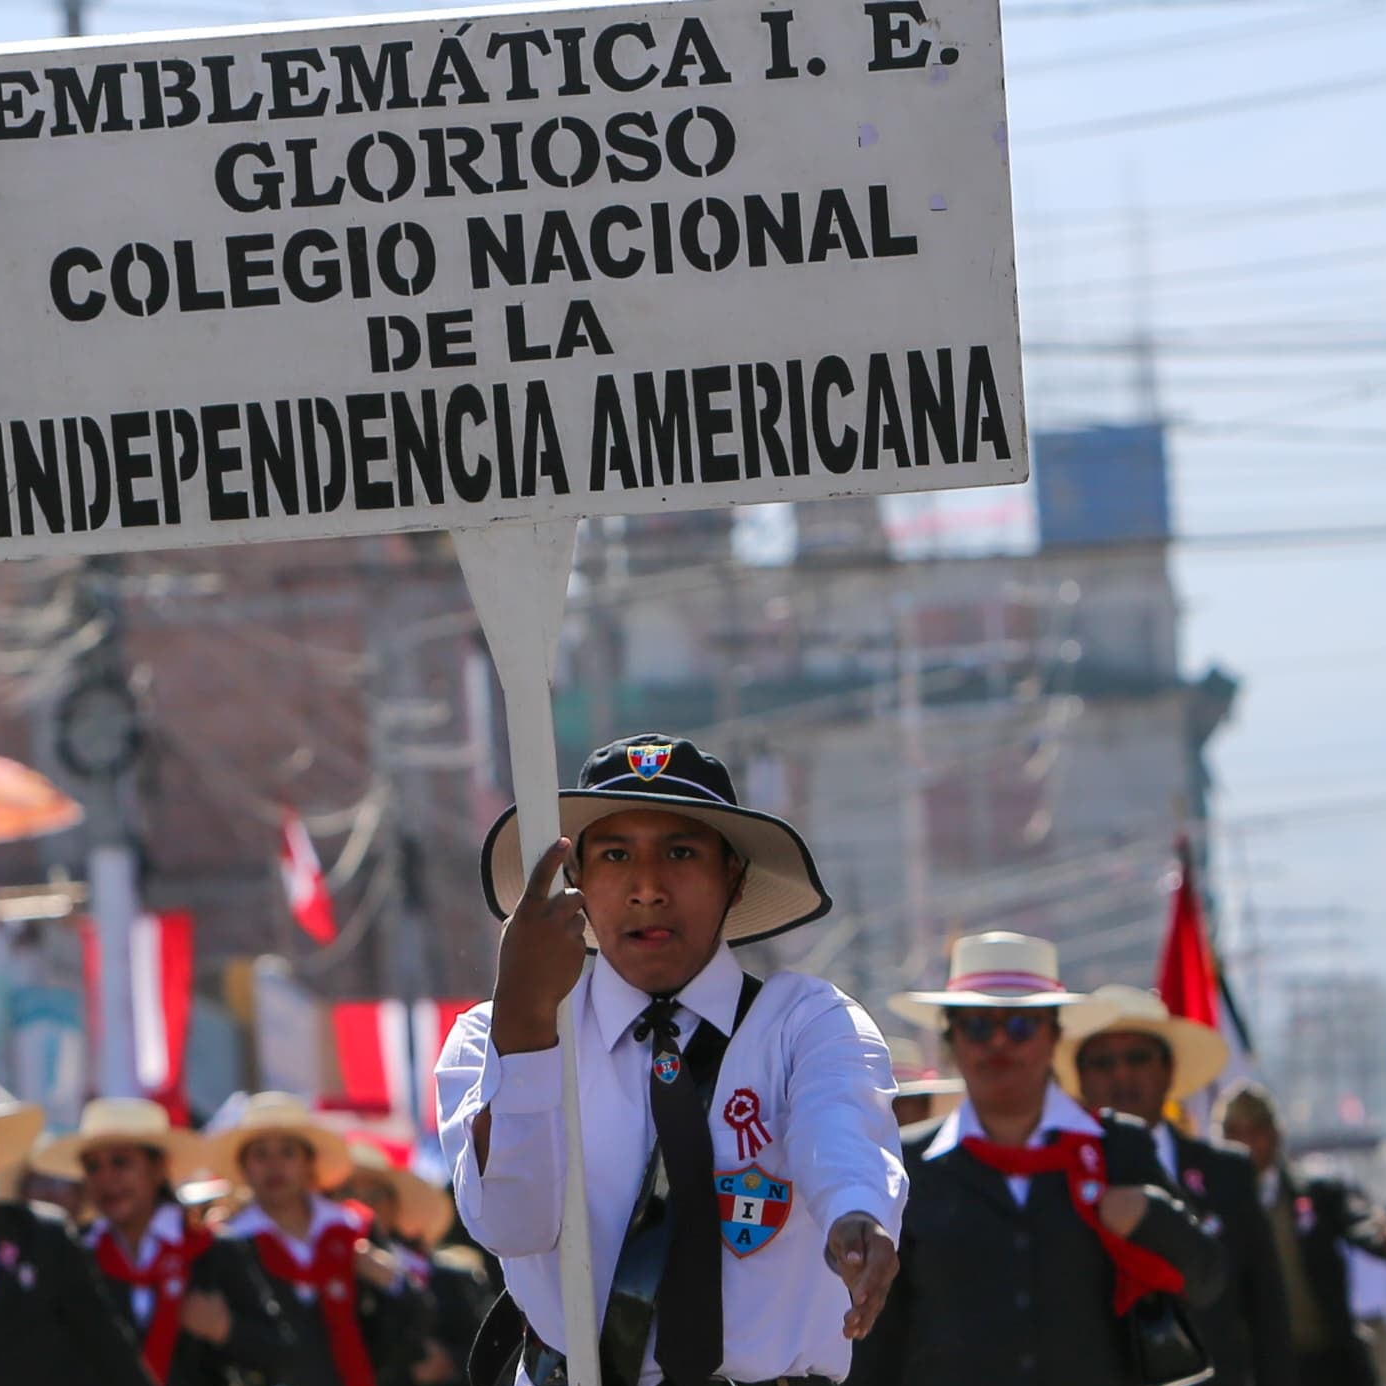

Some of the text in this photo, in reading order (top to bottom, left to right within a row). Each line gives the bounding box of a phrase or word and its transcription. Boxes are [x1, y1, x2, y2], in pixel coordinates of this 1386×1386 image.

[760, 9, 826, 80] I.
[864, 0, 959, 72] E.
[214, 106, 736, 213] GLORIOSO
[49, 185, 919, 322] COLEGIO NACIONAL
[366, 300, 615, 373] DE LA
[590, 346, 1012, 492] AMERICANA
[720, 1177, 784, 1199] C N
[742, 1202, 754, 1219] I
[736, 1228, 752, 1245] A
